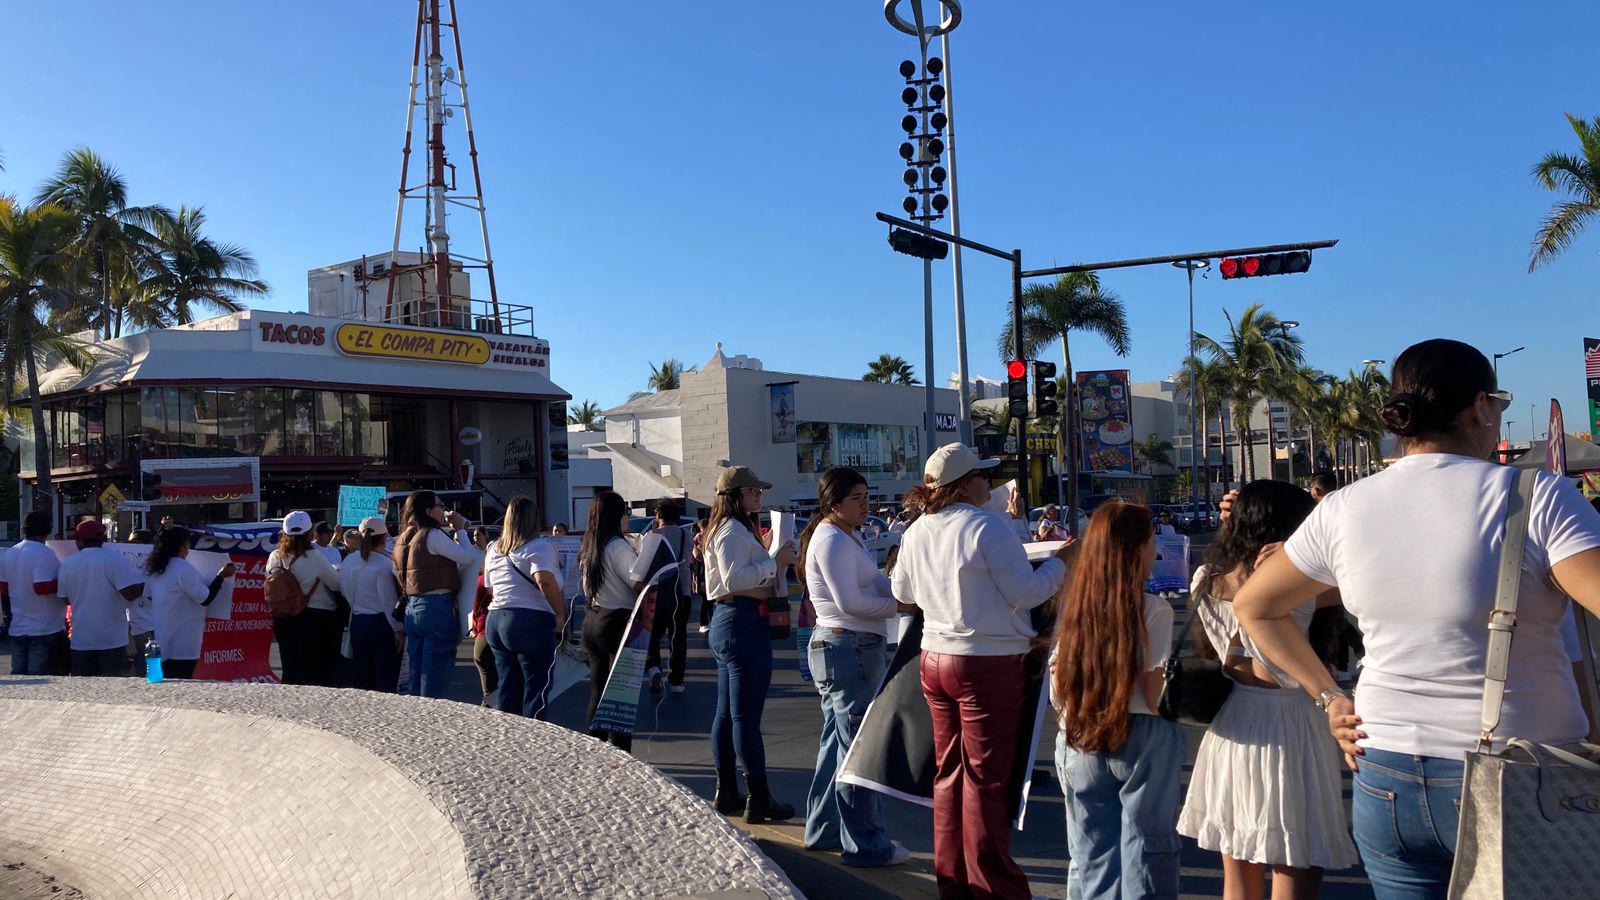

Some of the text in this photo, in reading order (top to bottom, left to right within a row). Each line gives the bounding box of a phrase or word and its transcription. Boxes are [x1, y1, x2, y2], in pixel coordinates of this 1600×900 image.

[259, 321, 326, 346] TACOS
[354, 330, 475, 357] EL COMPA PITY
[493, 354, 546, 368] SINALOA
[225, 620, 234, 631] DE
